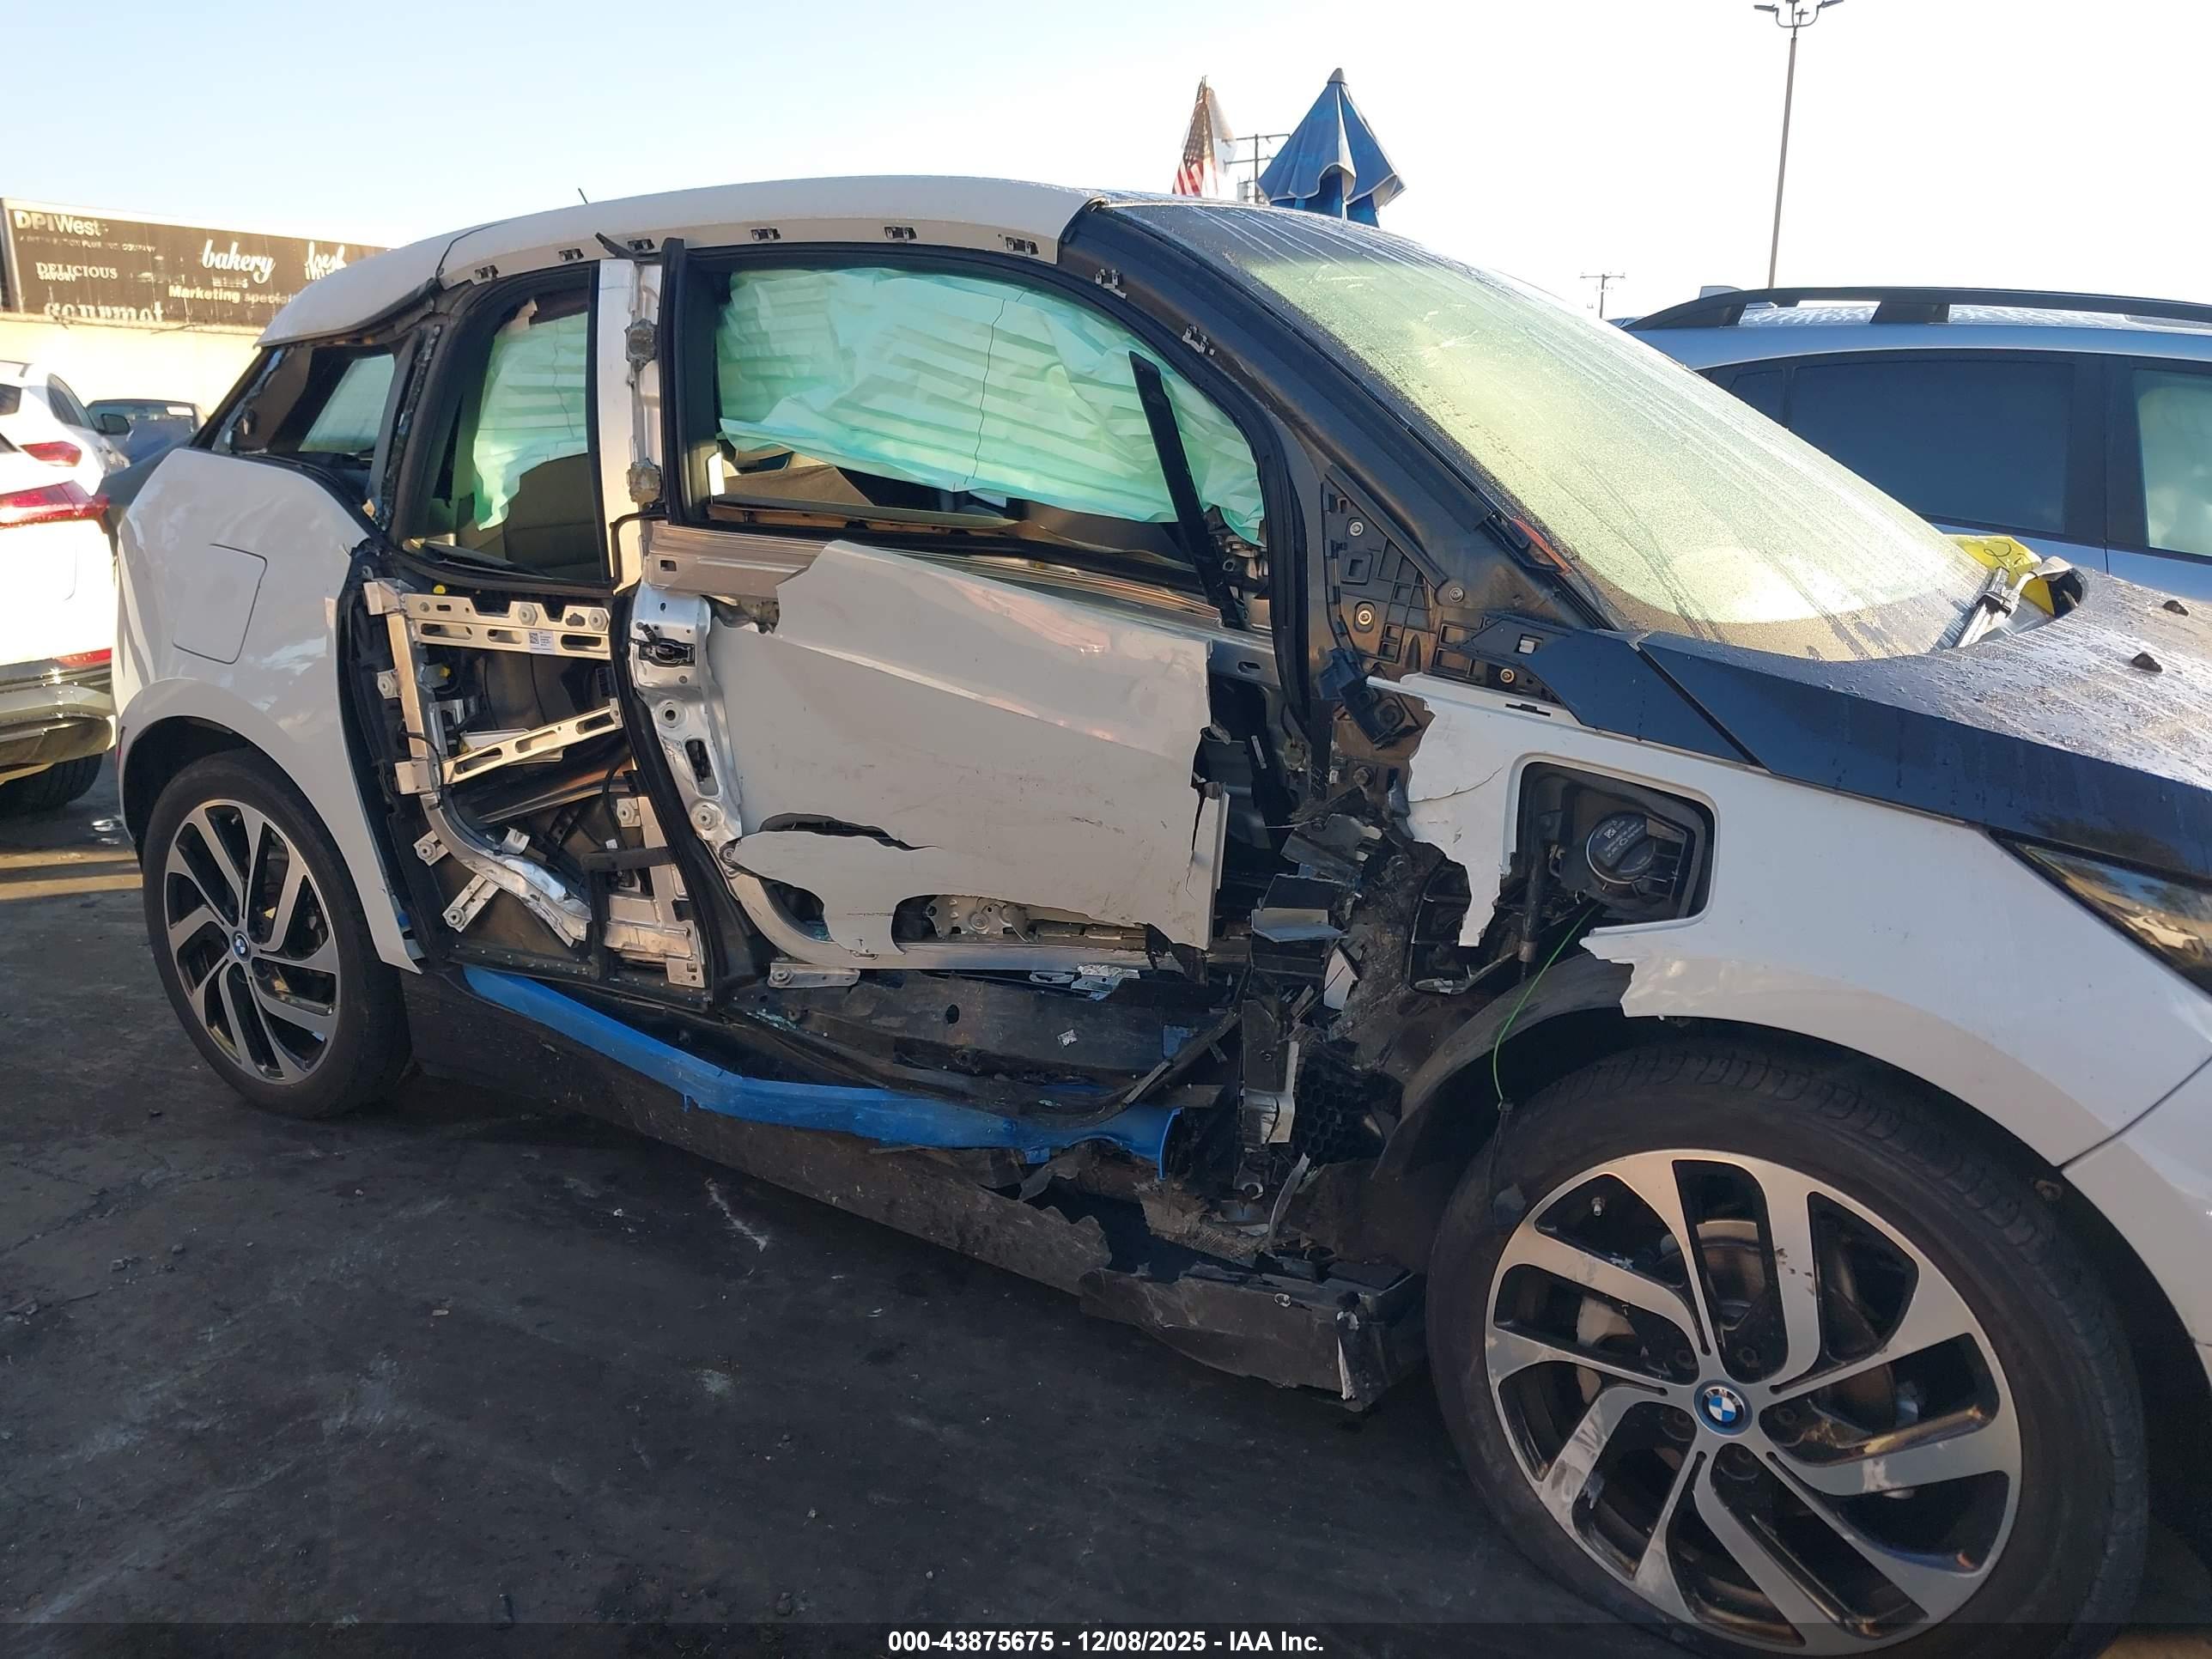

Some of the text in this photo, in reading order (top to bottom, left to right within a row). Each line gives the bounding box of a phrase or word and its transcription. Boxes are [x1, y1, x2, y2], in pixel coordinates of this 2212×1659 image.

[35, 262, 118, 280] DELICIOUS
[201, 238, 276, 284] bakery
[168, 284, 240, 304] Marketing
